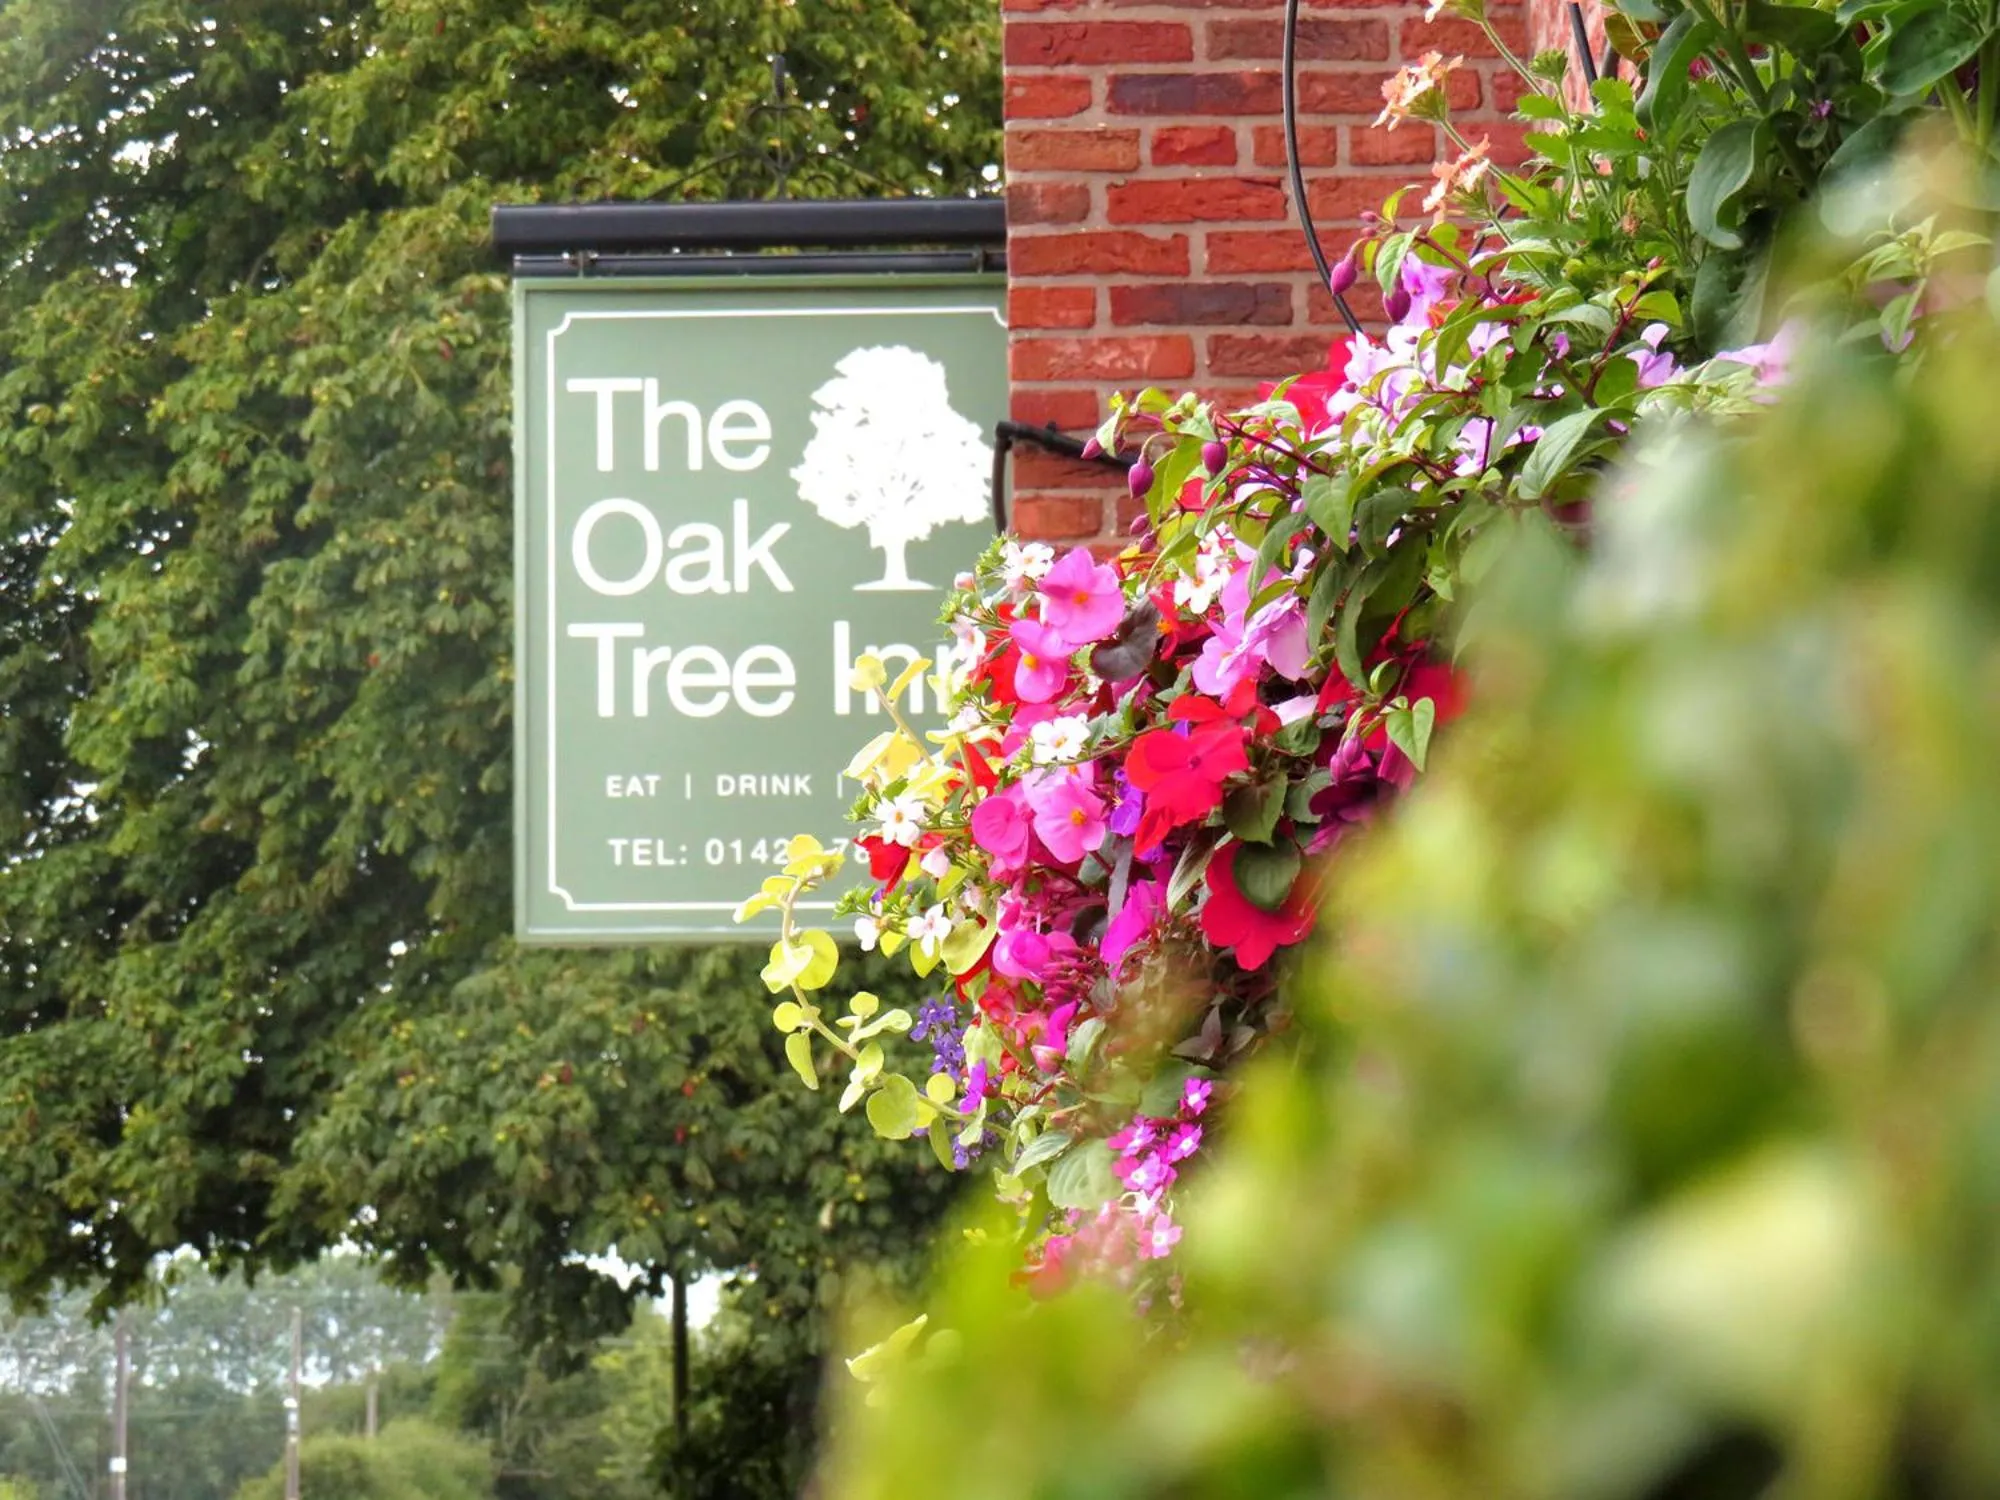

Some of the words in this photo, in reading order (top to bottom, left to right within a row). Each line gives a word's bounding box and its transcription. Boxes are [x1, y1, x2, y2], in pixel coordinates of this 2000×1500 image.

[566, 377, 772, 471] The
[571, 497, 794, 595] Oak
[567, 622, 796, 717] Tree
[606, 774, 660, 797] EAT
[716, 774, 812, 796] DRINK
[608, 838, 688, 865] TEL:
[705, 837, 791, 865] 0142
